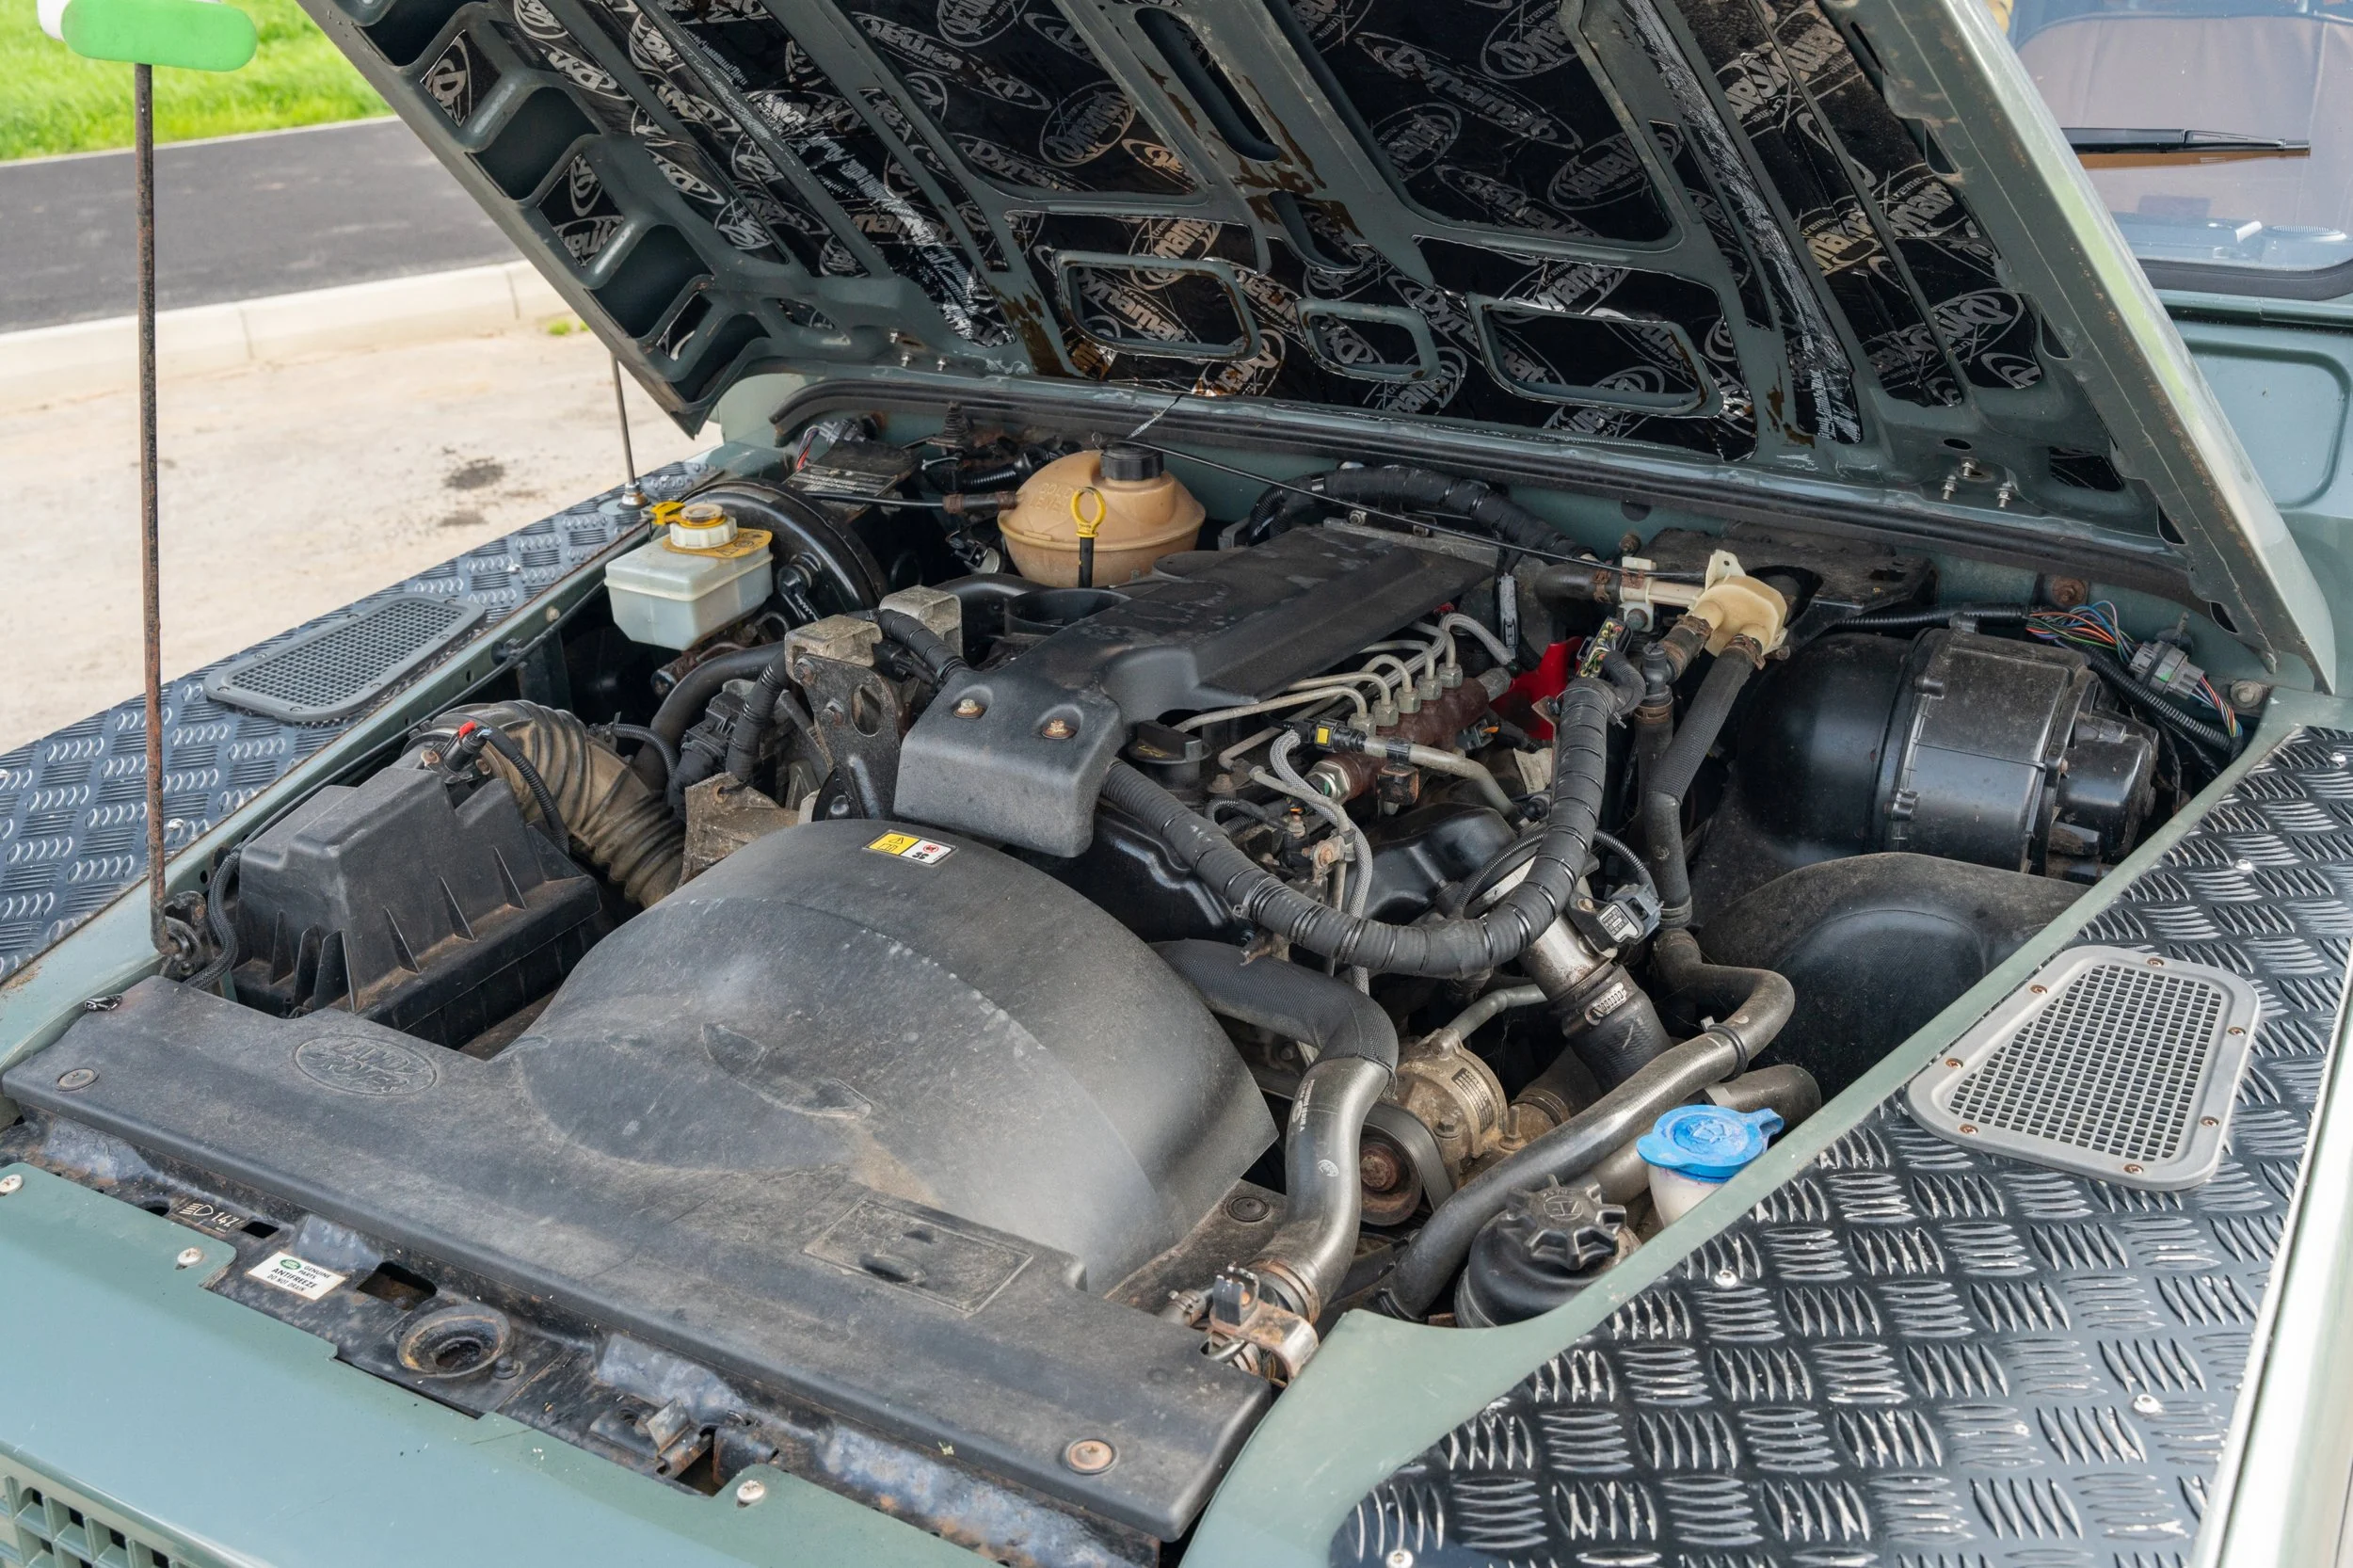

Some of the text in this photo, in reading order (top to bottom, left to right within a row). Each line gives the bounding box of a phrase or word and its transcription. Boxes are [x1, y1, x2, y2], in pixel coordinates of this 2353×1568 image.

[271, 1267, 317, 1289] ANTIFREEZE
[298, 1270, 316, 1280] PARTS
[303, 1265, 332, 1279] GENUINE
[277, 1276, 288, 1287] NOT
[287, 1281, 307, 1292] DRAIN
